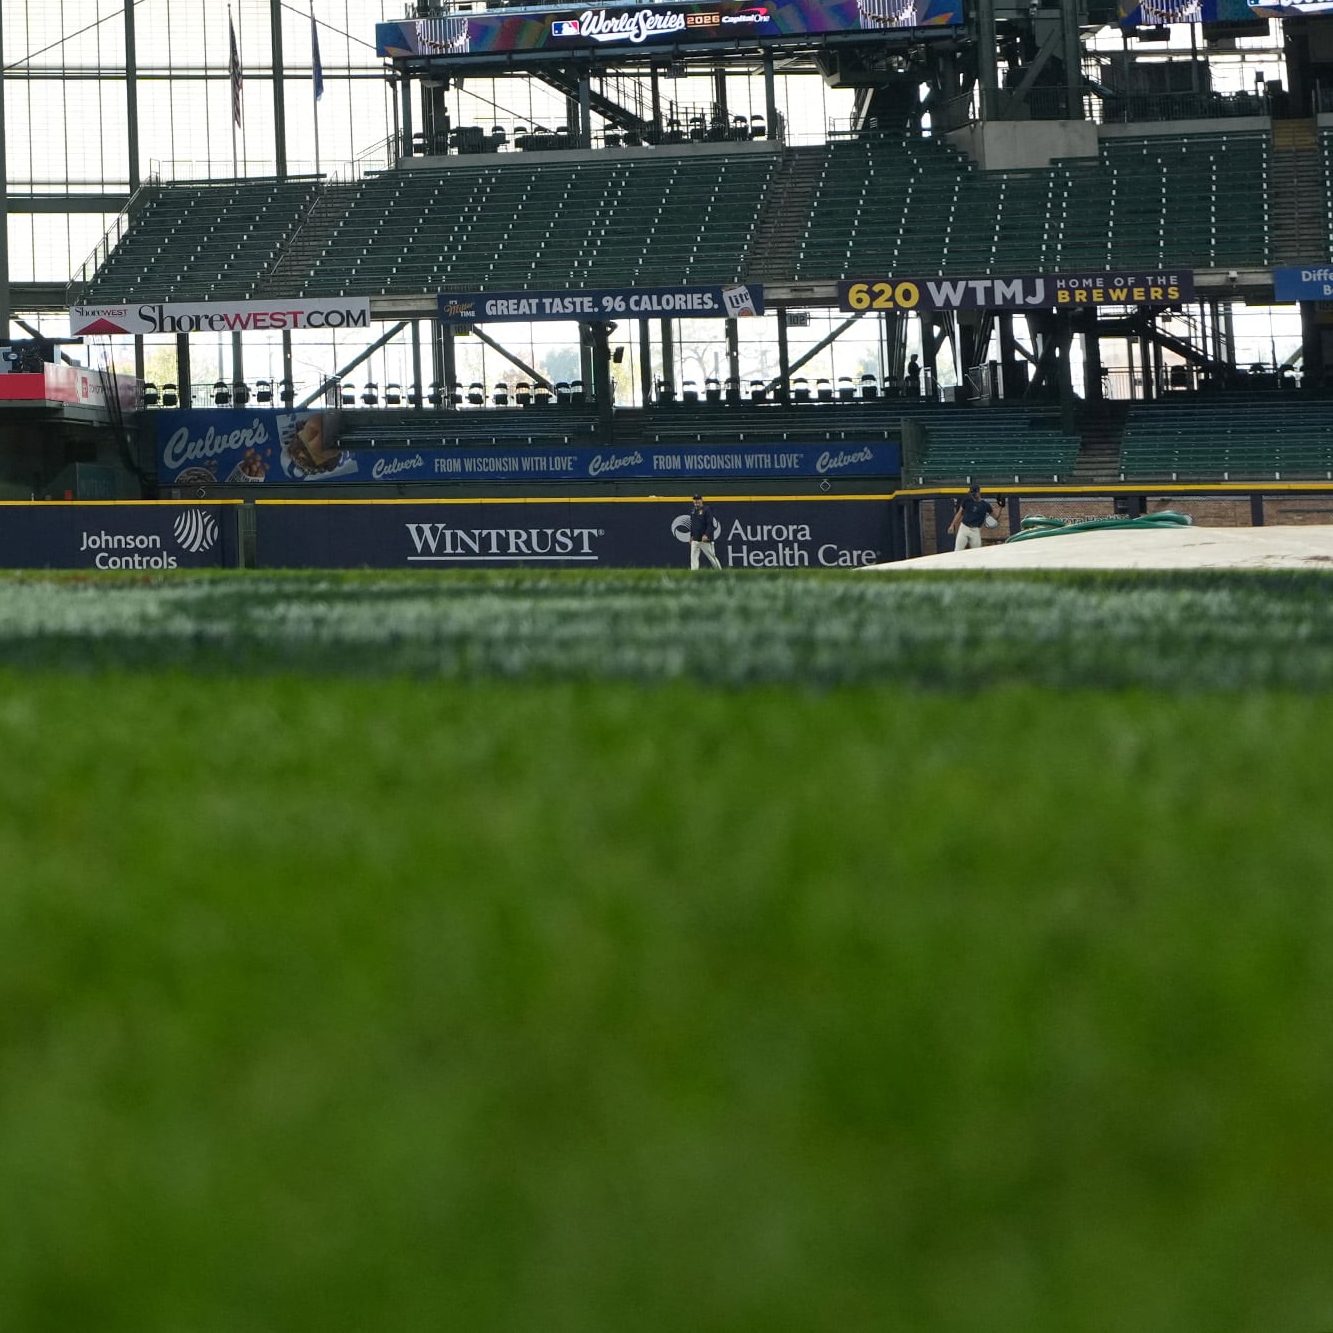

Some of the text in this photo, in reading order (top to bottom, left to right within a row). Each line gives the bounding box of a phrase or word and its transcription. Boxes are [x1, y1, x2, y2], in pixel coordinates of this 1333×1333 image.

[686, 16, 720, 25] 2026
[1056, 275, 1179, 288] HOME OF THE
[485, 293, 719, 315] GREAT TASTE. 96 CALORIES.
[848, 278, 1045, 310] 620 WTMJ
[1057, 286, 1180, 303] BREWERS
[163, 418, 269, 467] Culver's
[372, 454, 424, 479] Culver's
[434, 456, 573, 473] FROM WISCONSIN WITH LOVE
[588, 450, 643, 476] Culver's
[653, 453, 799, 470] FROM WISCONSIN WITH LOVE
[815, 446, 874, 474] Culver's
[80, 530, 161, 551] Johnson
[728, 519, 812, 541] Aurora
[95, 551, 178, 570] Controls
[727, 544, 877, 567] Health Care
